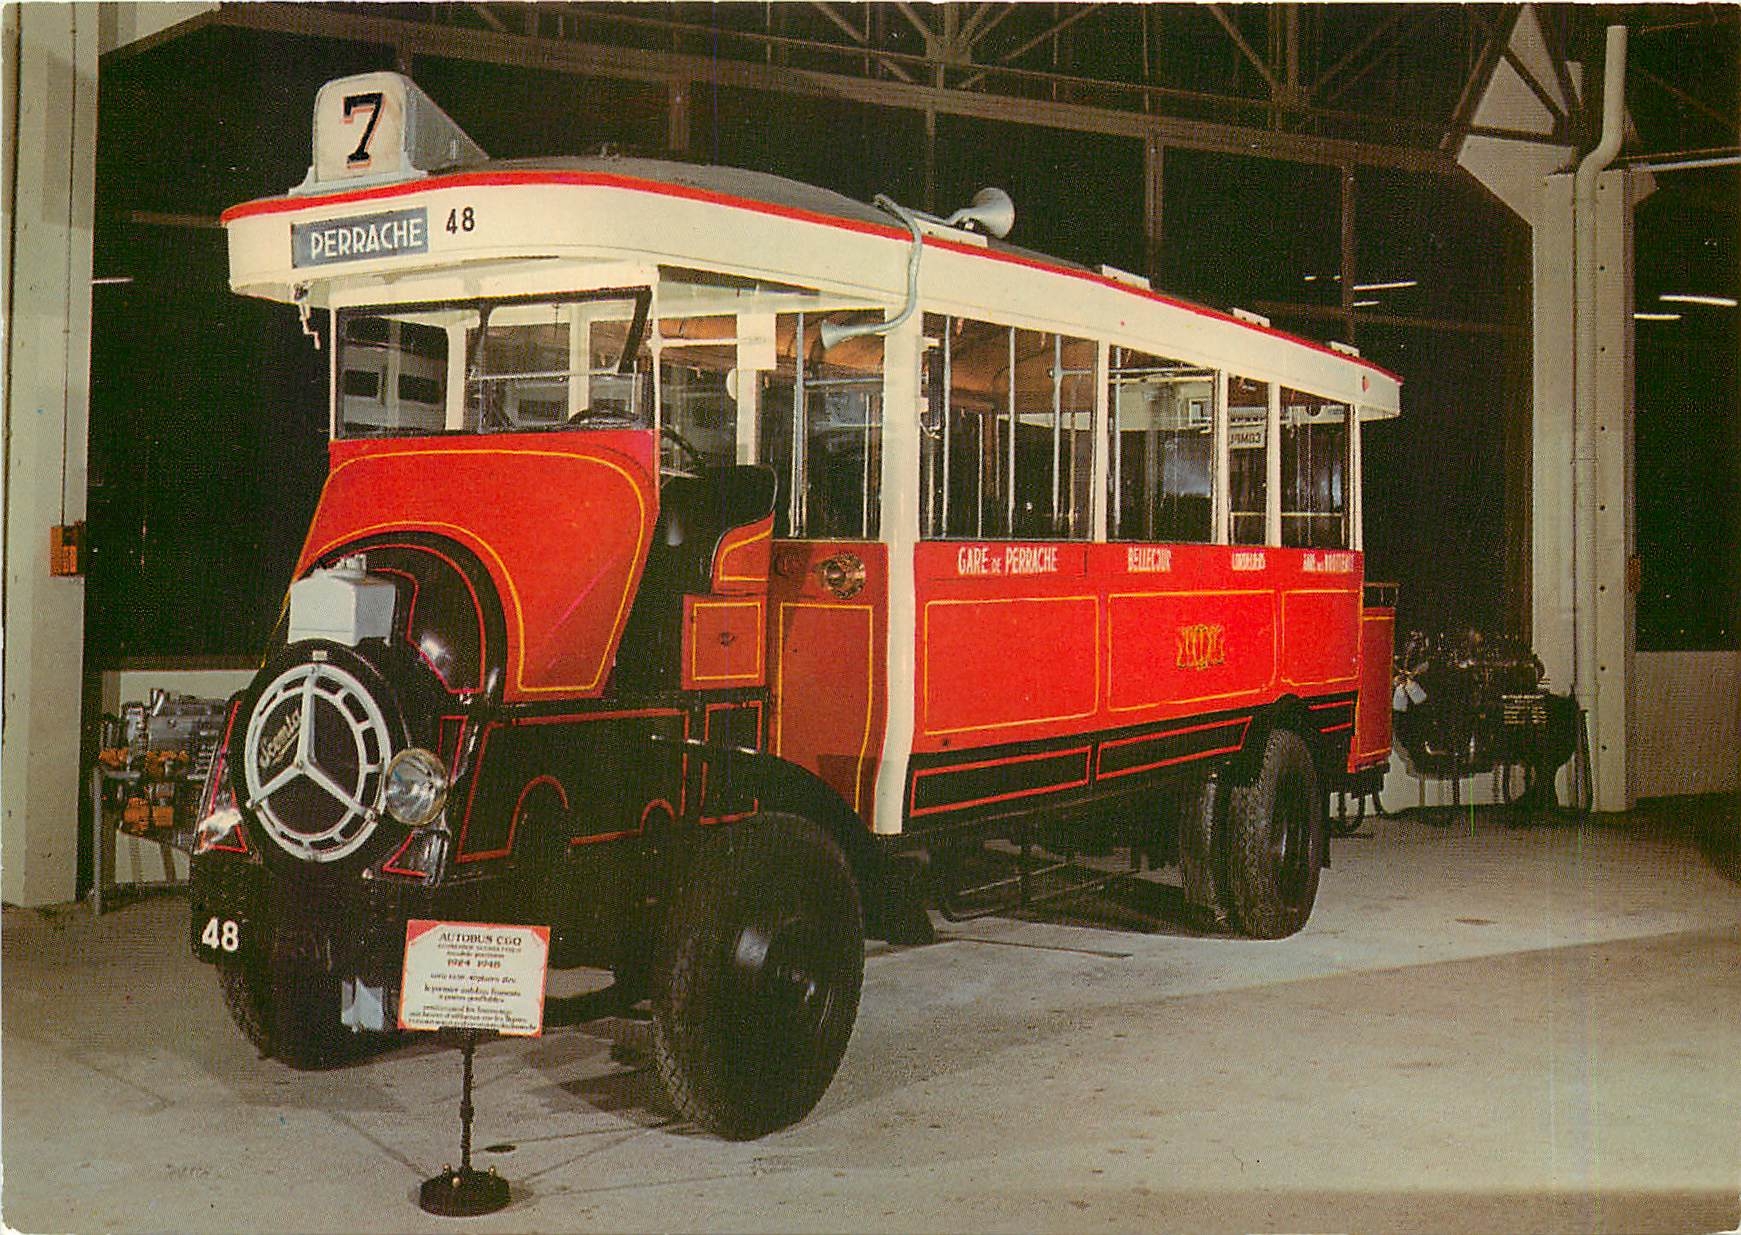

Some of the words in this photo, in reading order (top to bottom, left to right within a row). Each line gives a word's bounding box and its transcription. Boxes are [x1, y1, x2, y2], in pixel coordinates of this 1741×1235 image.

[341, 92, 386, 169] 7
[445, 206, 476, 235] 48
[310, 217, 423, 260] PERRACHE
[957, 547, 989, 576] GARE
[1004, 547, 1059, 574] PERRACHE
[201, 916, 239, 951] 48
[439, 932, 493, 944] AUTOBUS
